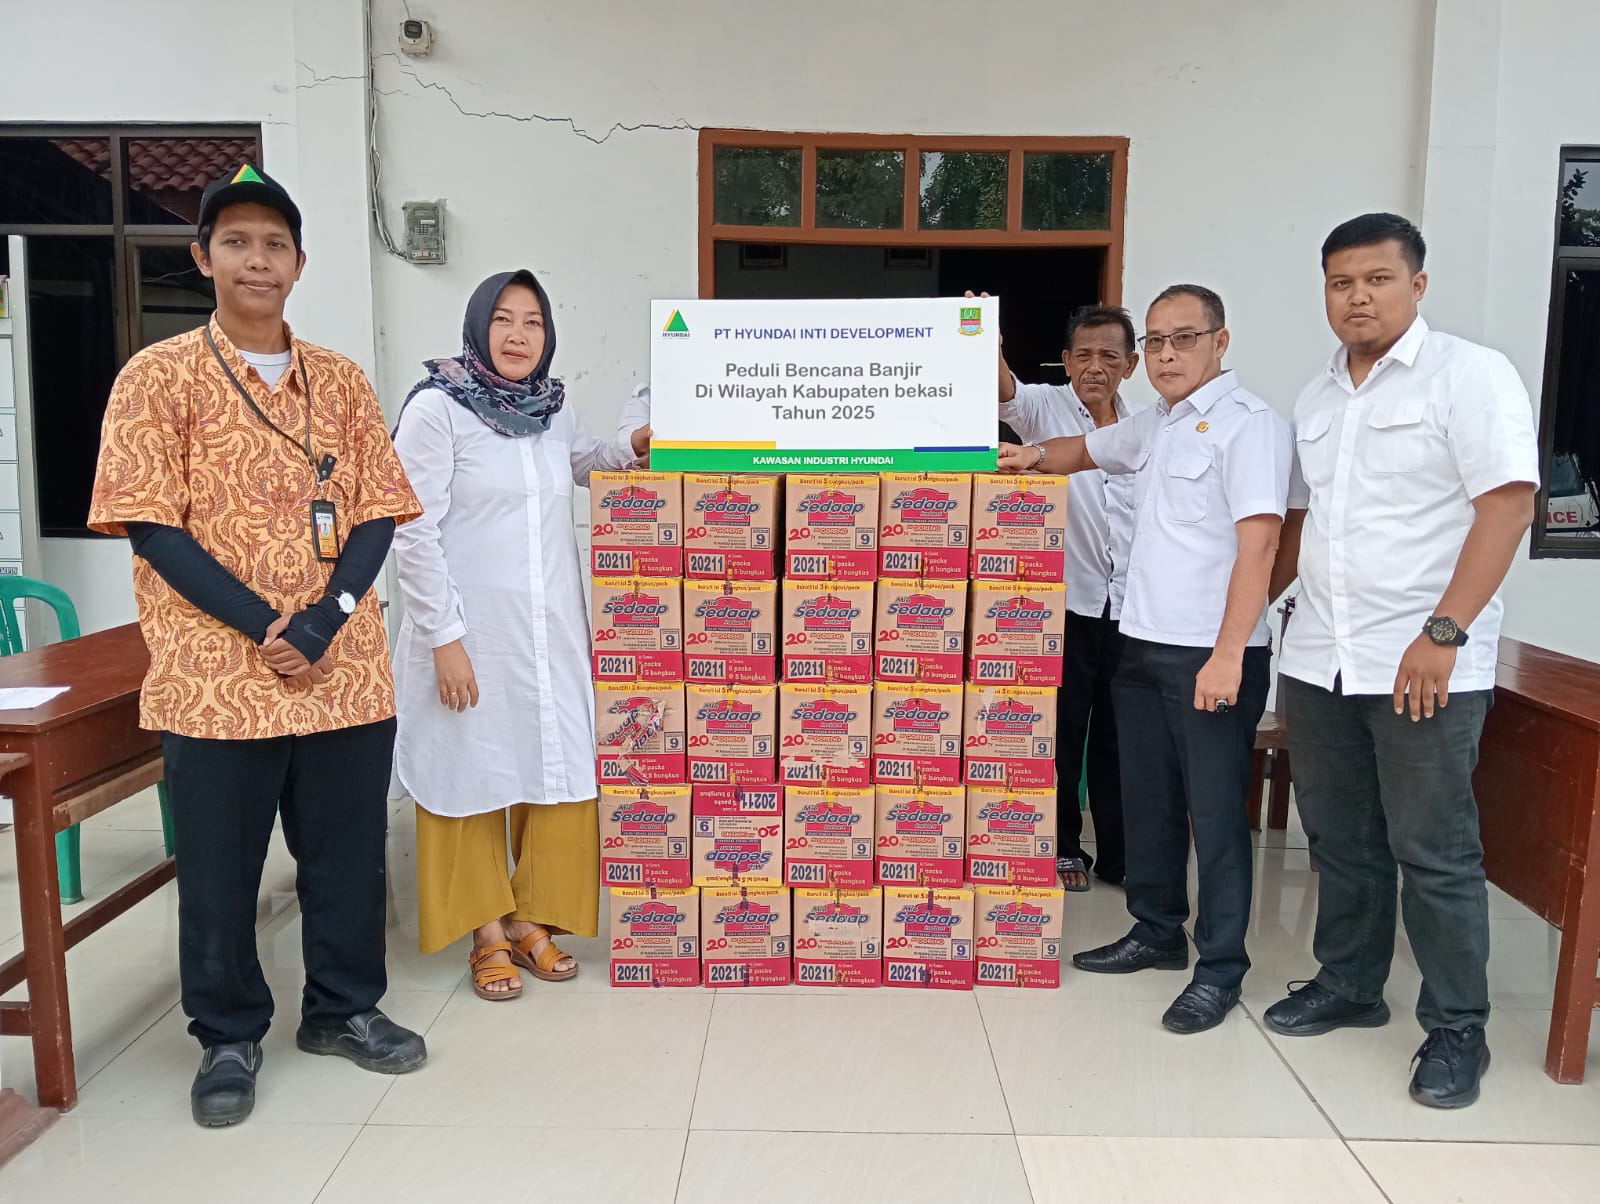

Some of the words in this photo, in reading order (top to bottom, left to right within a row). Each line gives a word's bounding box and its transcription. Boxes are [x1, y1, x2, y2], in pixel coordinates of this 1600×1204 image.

[714, 328, 731, 339] PT
[735, 328, 796, 339] HYUNDAI
[800, 328, 826, 339] INTI
[830, 328, 934, 338] DEVELOPMENT
[726, 362, 780, 377] Peduli
[786, 363, 864, 377] Bencana
[870, 362, 922, 380] Banjir
[696, 384, 712, 398] Di
[718, 384, 787, 402] Wilayah
[793, 384, 888, 402] Kabupaten
[895, 383, 952, 398] bekasi
[772, 405, 826, 420] Tahun
[832, 405, 874, 420] 2025
[752, 456, 800, 464] KAWASAN
[804, 456, 848, 464] INDUSTRI
[851, 456, 894, 464] HYUNDAI
[600, 496, 666, 511] Sedaap
[694, 500, 759, 515] Sedaap
[798, 500, 864, 515] Sedaap
[891, 497, 957, 512] Sedaap
[986, 500, 1055, 516] Sedaap
[592, 524, 614, 536] 20
[663, 530, 673, 540] 9
[686, 526, 707, 540] 20
[789, 528, 811, 541] 20
[882, 524, 904, 537] 20
[952, 531, 962, 541] 9
[977, 527, 999, 540] 20
[756, 534, 765, 544] 9
[860, 534, 870, 544] 9
[1049, 534, 1060, 545] 9
[598, 552, 631, 569] 20211
[690, 555, 723, 572] 20211
[793, 557, 827, 573] 20211
[886, 553, 919, 570] 20211
[980, 556, 1015, 573] 20211
[602, 602, 668, 616] Sedaap
[694, 606, 760, 621] Sedaap
[794, 606, 859, 620] Sedaap
[887, 603, 952, 619] Sedaap
[986, 607, 1052, 622] Sedaap
[595, 629, 616, 642] 20
[665, 635, 674, 645] 9
[686, 632, 708, 645] 20
[786, 632, 807, 645] 20
[879, 629, 900, 642] 20
[947, 637, 957, 648] 9
[977, 633, 998, 646] 20
[757, 639, 766, 650] 9
[856, 639, 865, 649] 9
[1047, 640, 1057, 650] 9
[601, 657, 633, 673] 20211
[691, 661, 724, 677] 20211
[790, 661, 823, 677] 20211
[882, 658, 915, 675] 20211
[980, 662, 1014, 678] 20211
[696, 709, 761, 724] Sedaap
[791, 708, 857, 724] Sedaap
[884, 707, 949, 723] Sedaap
[668, 737, 677, 748] 9
[688, 735, 709, 748] 20
[783, 734, 804, 748] 20
[875, 732, 896, 746] 20
[944, 741, 954, 751] 9
[966, 735, 988, 748] 20
[758, 742, 767, 752] 9
[853, 742, 862, 752] 9
[1037, 743, 1047, 753] 9
[693, 763, 726, 779] 20211
[879, 760, 912, 777] 20211
[970, 763, 1004, 780] 20211
[742, 794, 775, 809] 20211
[611, 811, 676, 825] Sedaap
[795, 811, 860, 826] Sedaap
[886, 810, 951, 825] Sedaap
[978, 808, 1043, 825] Sedaap
[603, 837, 624, 849] 20
[787, 837, 808, 850] 20
[878, 835, 899, 848] 20
[969, 833, 990, 847] 20
[1039, 842, 1049, 852] 9
[673, 843, 682, 853] 9
[856, 844, 866, 854] 9
[947, 843, 957, 853] 9
[608, 865, 641, 880] 20211
[791, 865, 824, 881] 20211
[882, 863, 915, 880] 20211
[973, 861, 1006, 878] 20211
[620, 911, 685, 926] Sedaap
[715, 911, 777, 926] Sedaap
[895, 911, 960, 927] Sedaap
[985, 911, 1051, 927] Sedaap
[613, 938, 633, 950] 20
[682, 942, 691, 952] 9
[707, 938, 727, 951] 20
[774, 942, 783, 952] 9
[797, 938, 817, 950] 20
[865, 944, 874, 954] 9
[886, 936, 908, 950] 20
[977, 936, 998, 949] 20
[1047, 944, 1056, 954] 9
[956, 945, 966, 955] 9
[618, 965, 650, 981] 20211
[712, 965, 743, 981] 20211
[801, 965, 833, 980] 20211
[890, 964, 924, 981] 20211
[980, 964, 1014, 980] 20211
